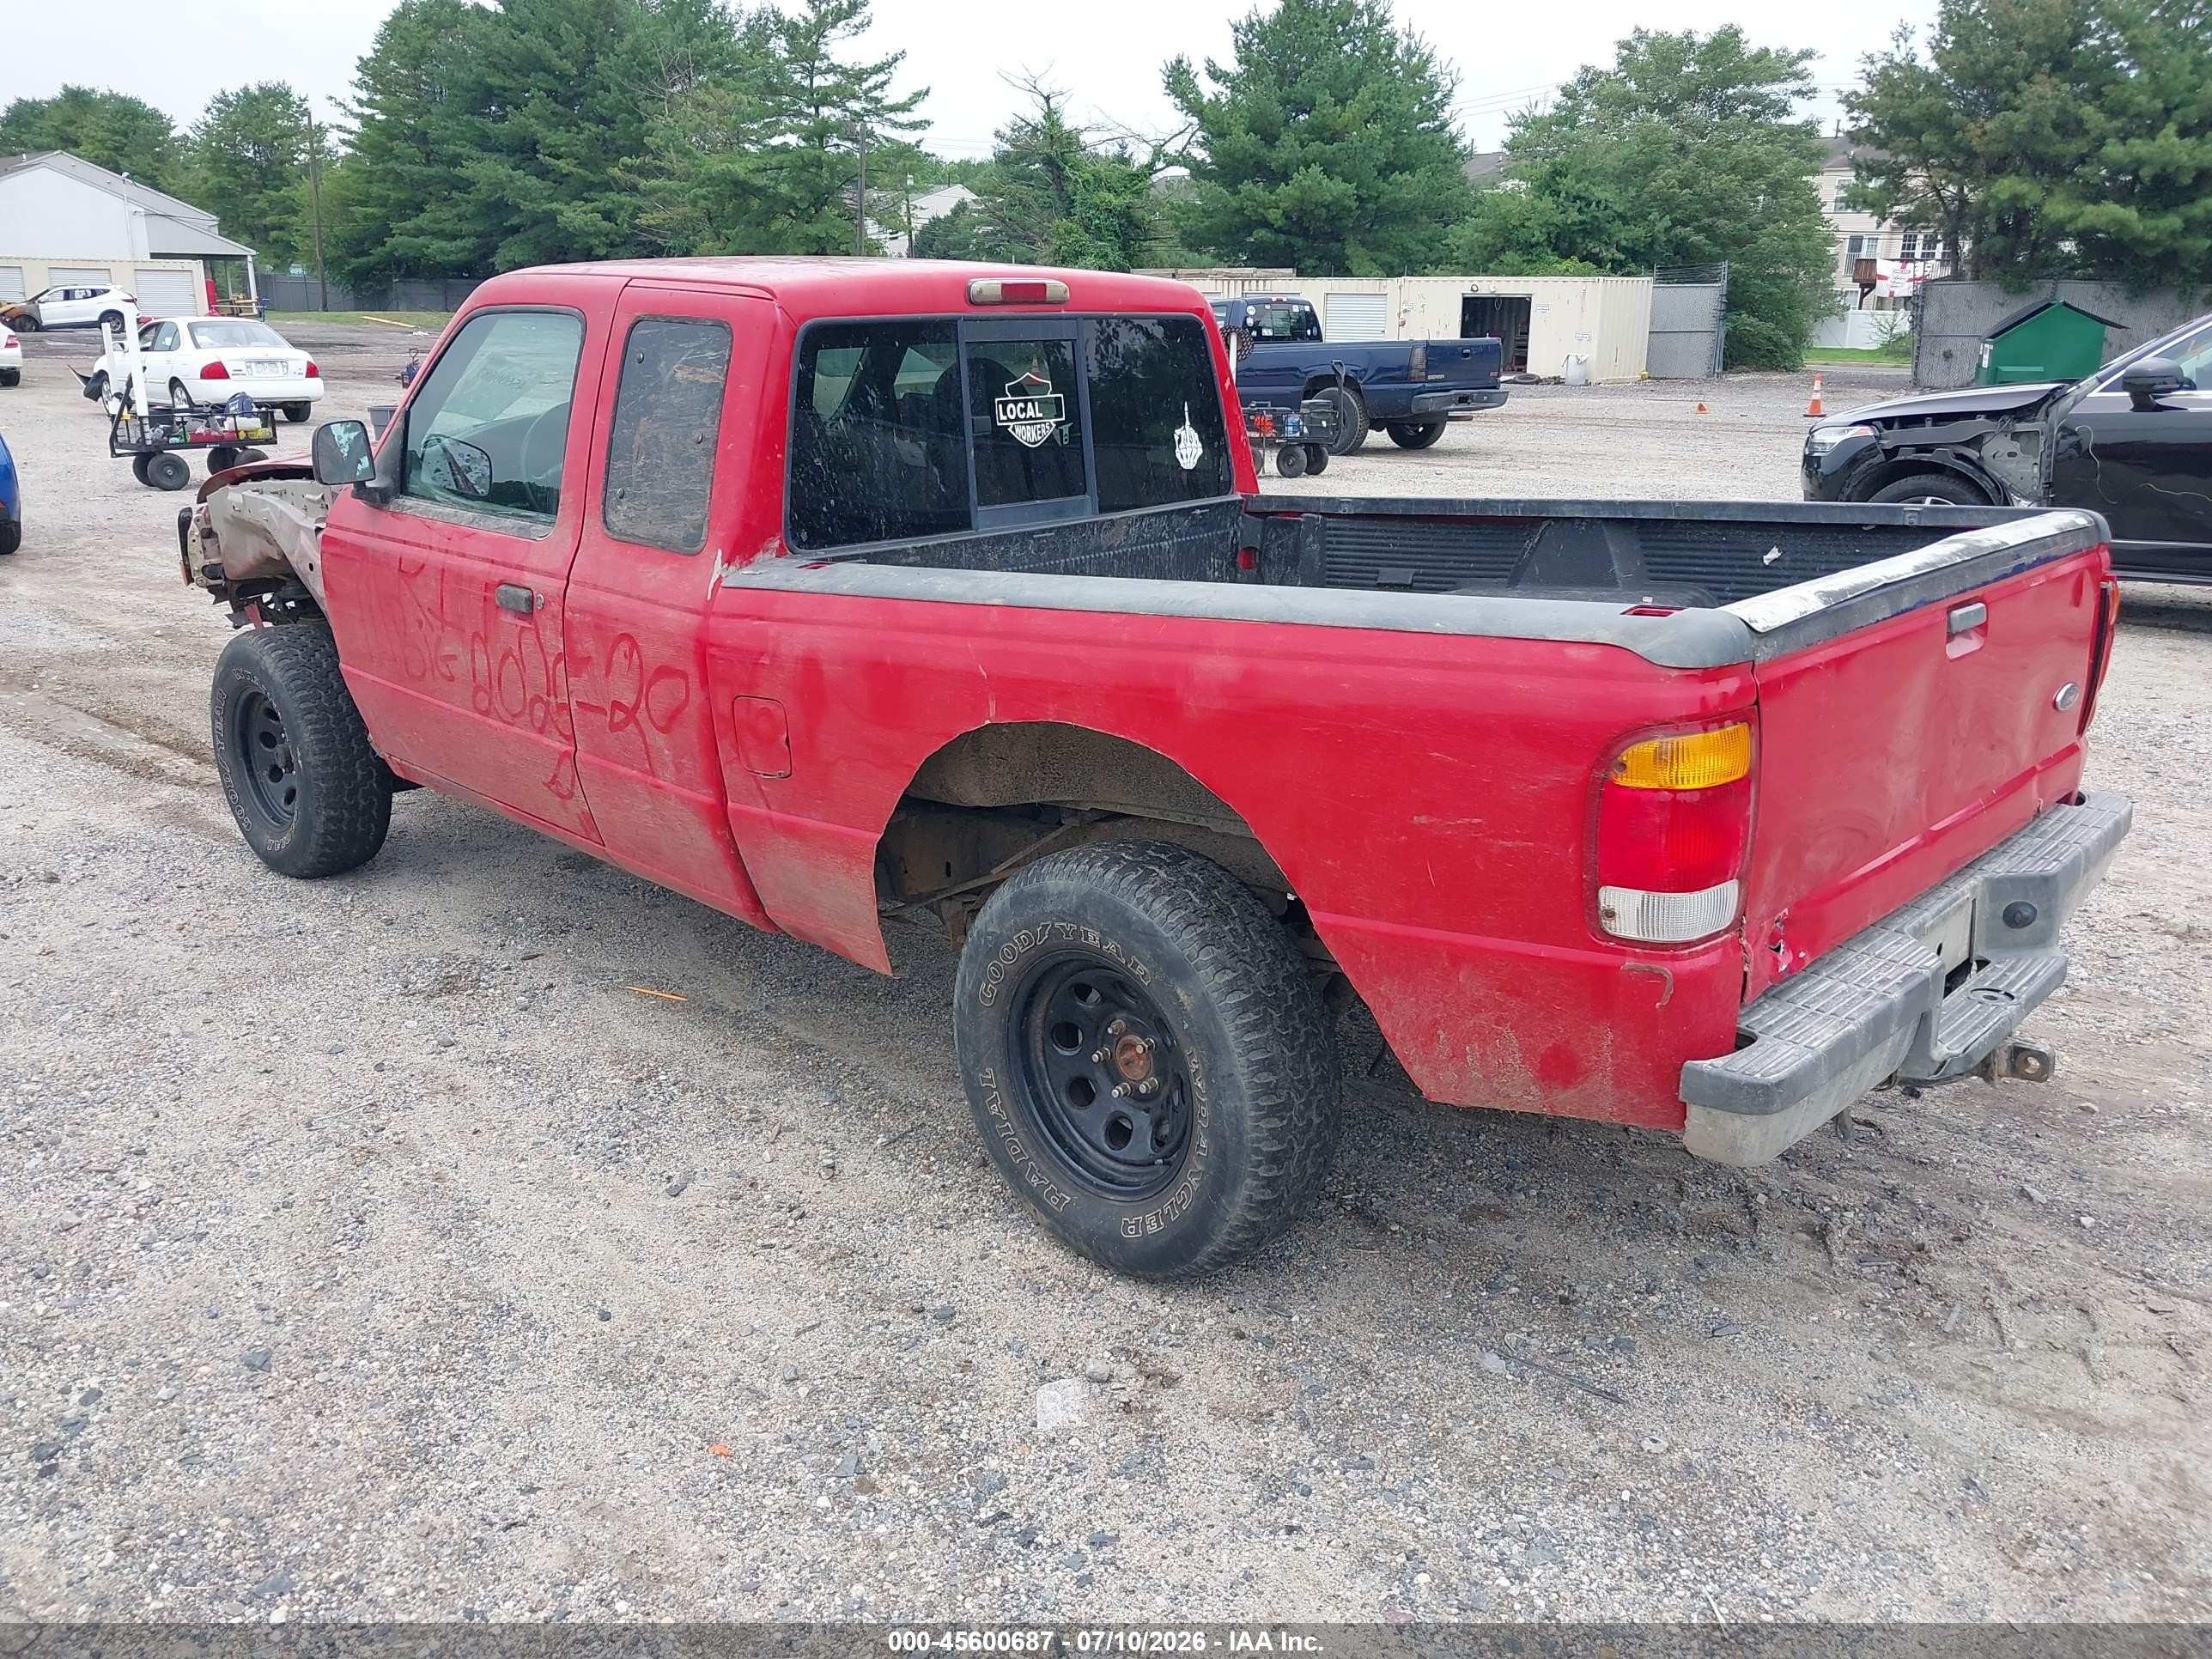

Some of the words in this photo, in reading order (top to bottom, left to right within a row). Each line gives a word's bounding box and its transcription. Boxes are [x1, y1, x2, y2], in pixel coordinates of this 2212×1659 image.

[998, 401, 1043, 421] LOCAL
[1014, 422, 1050, 443] WORKERS
[979, 1068, 1073, 1212] RADIAL
[1120, 1047, 1210, 1238] WRANGLER
